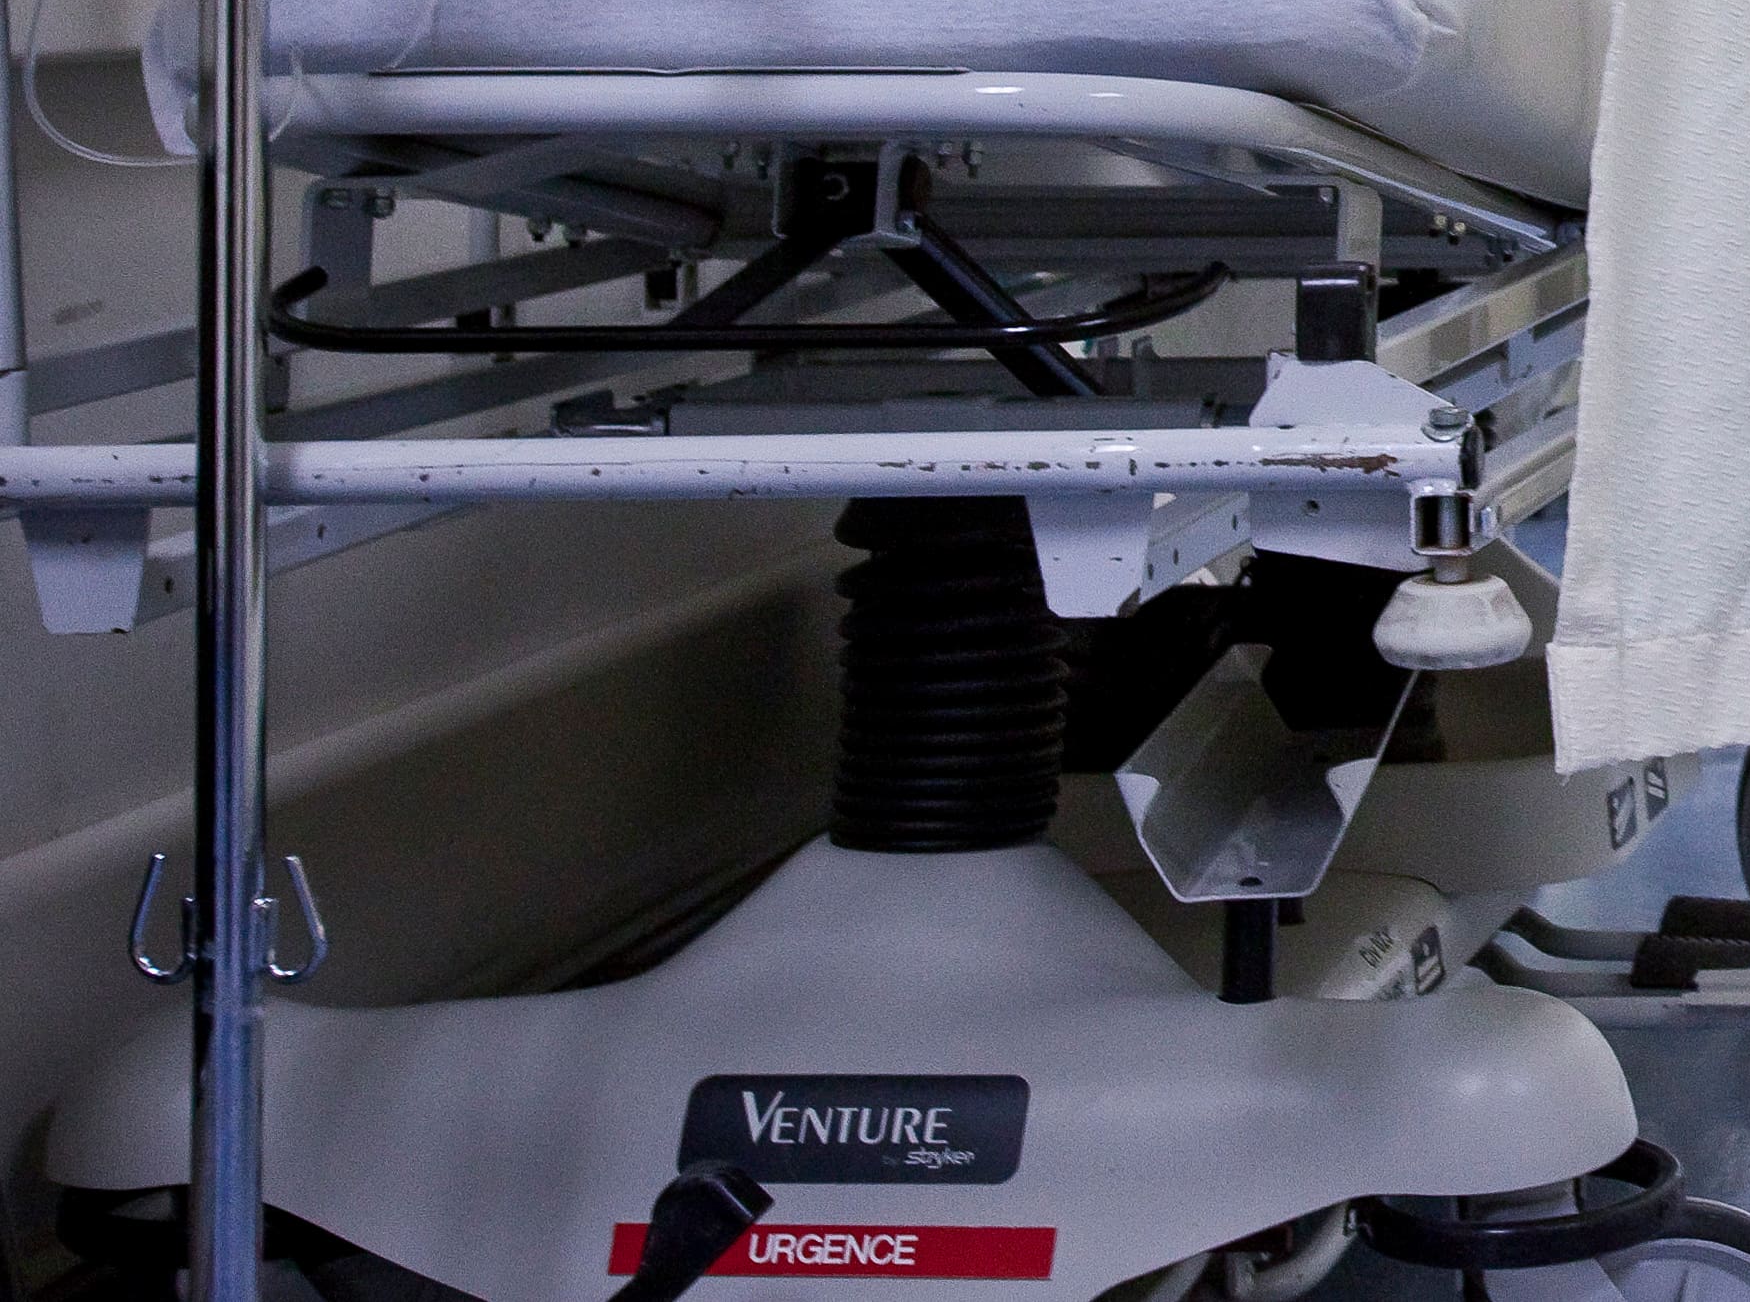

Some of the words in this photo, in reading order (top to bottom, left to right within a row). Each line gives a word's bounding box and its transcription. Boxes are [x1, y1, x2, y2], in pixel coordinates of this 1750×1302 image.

[742, 1090, 952, 1144] VENTURE
[903, 1146, 975, 1169] stryker
[749, 1232, 919, 1265] URGENCE
